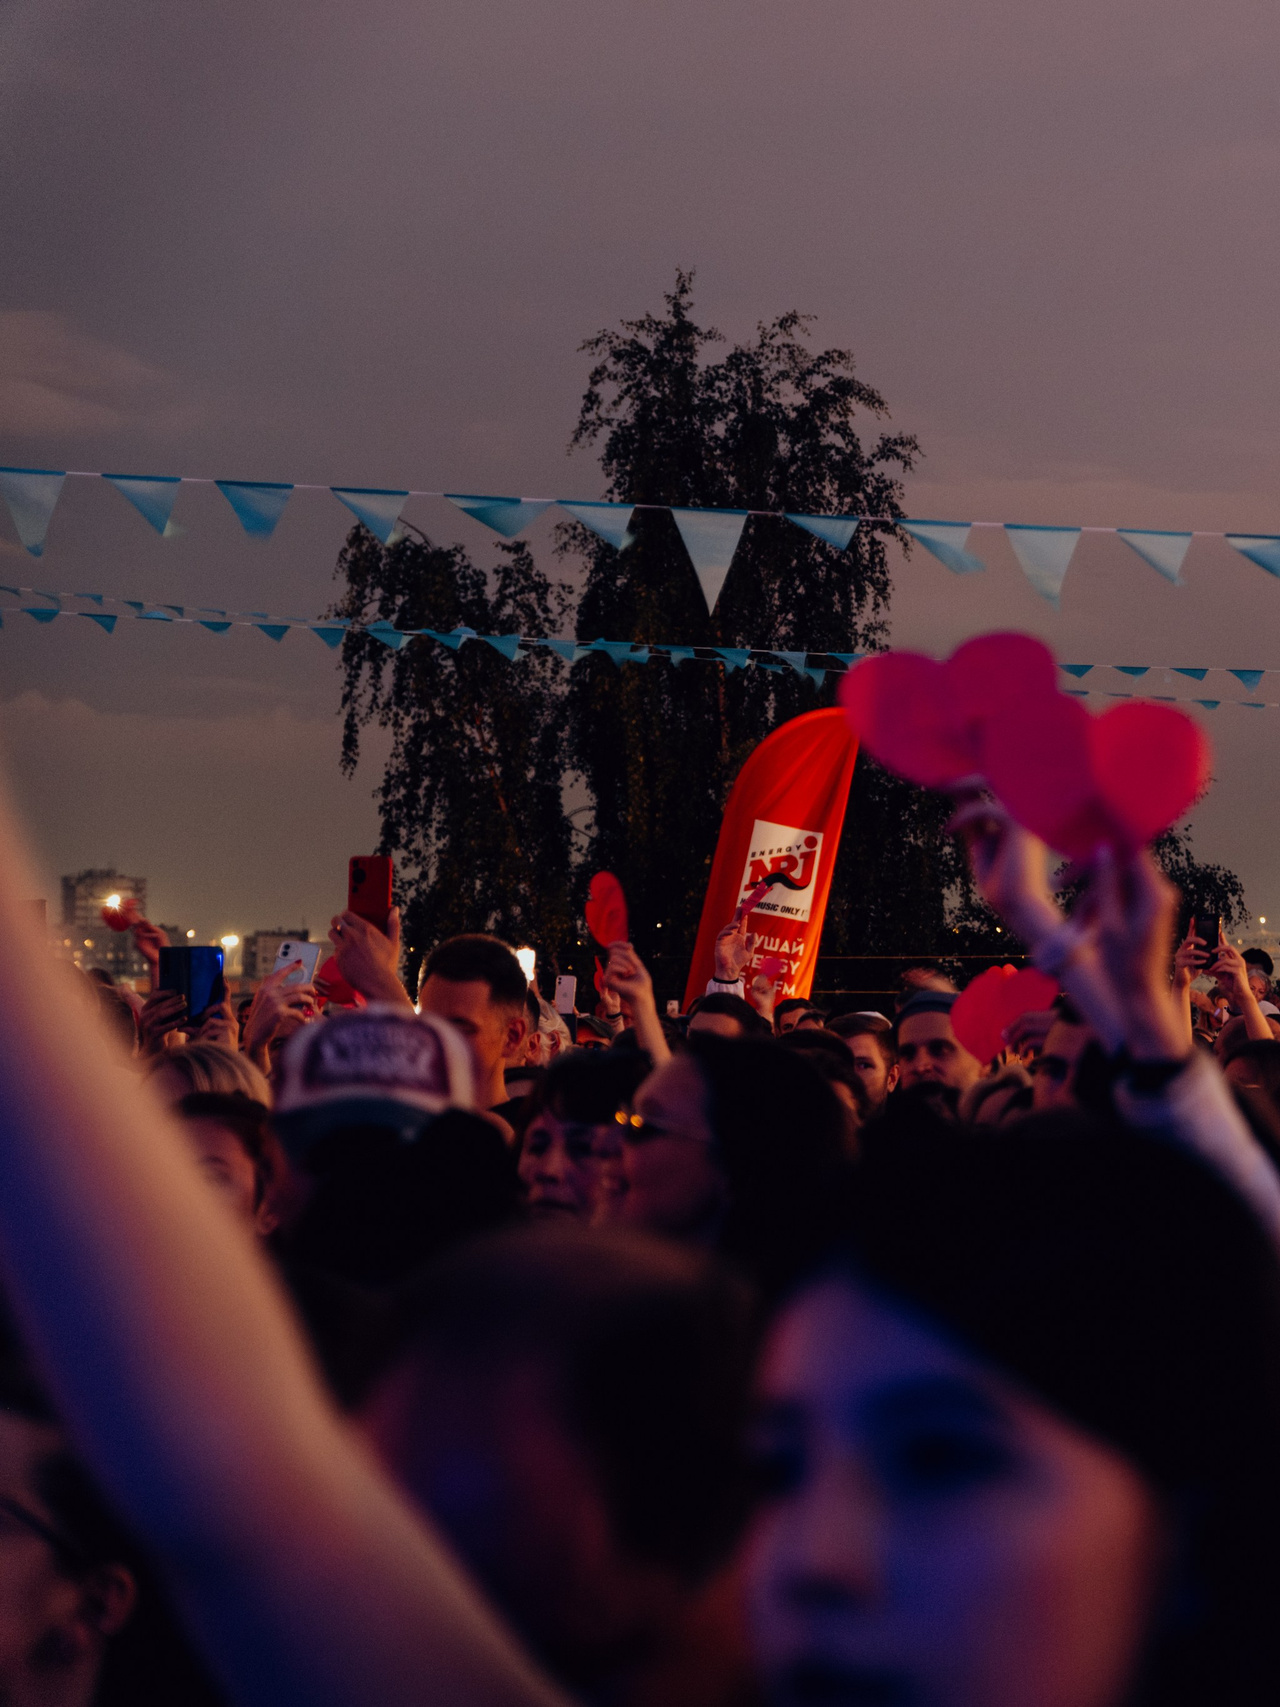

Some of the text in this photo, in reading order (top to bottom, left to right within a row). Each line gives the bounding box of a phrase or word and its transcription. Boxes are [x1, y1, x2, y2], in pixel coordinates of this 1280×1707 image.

[751, 844, 802, 858] ENERGY
[780, 905, 800, 916] ONLY
[745, 932, 805, 956] УШАЙ
[745, 953, 801, 976] EGY
